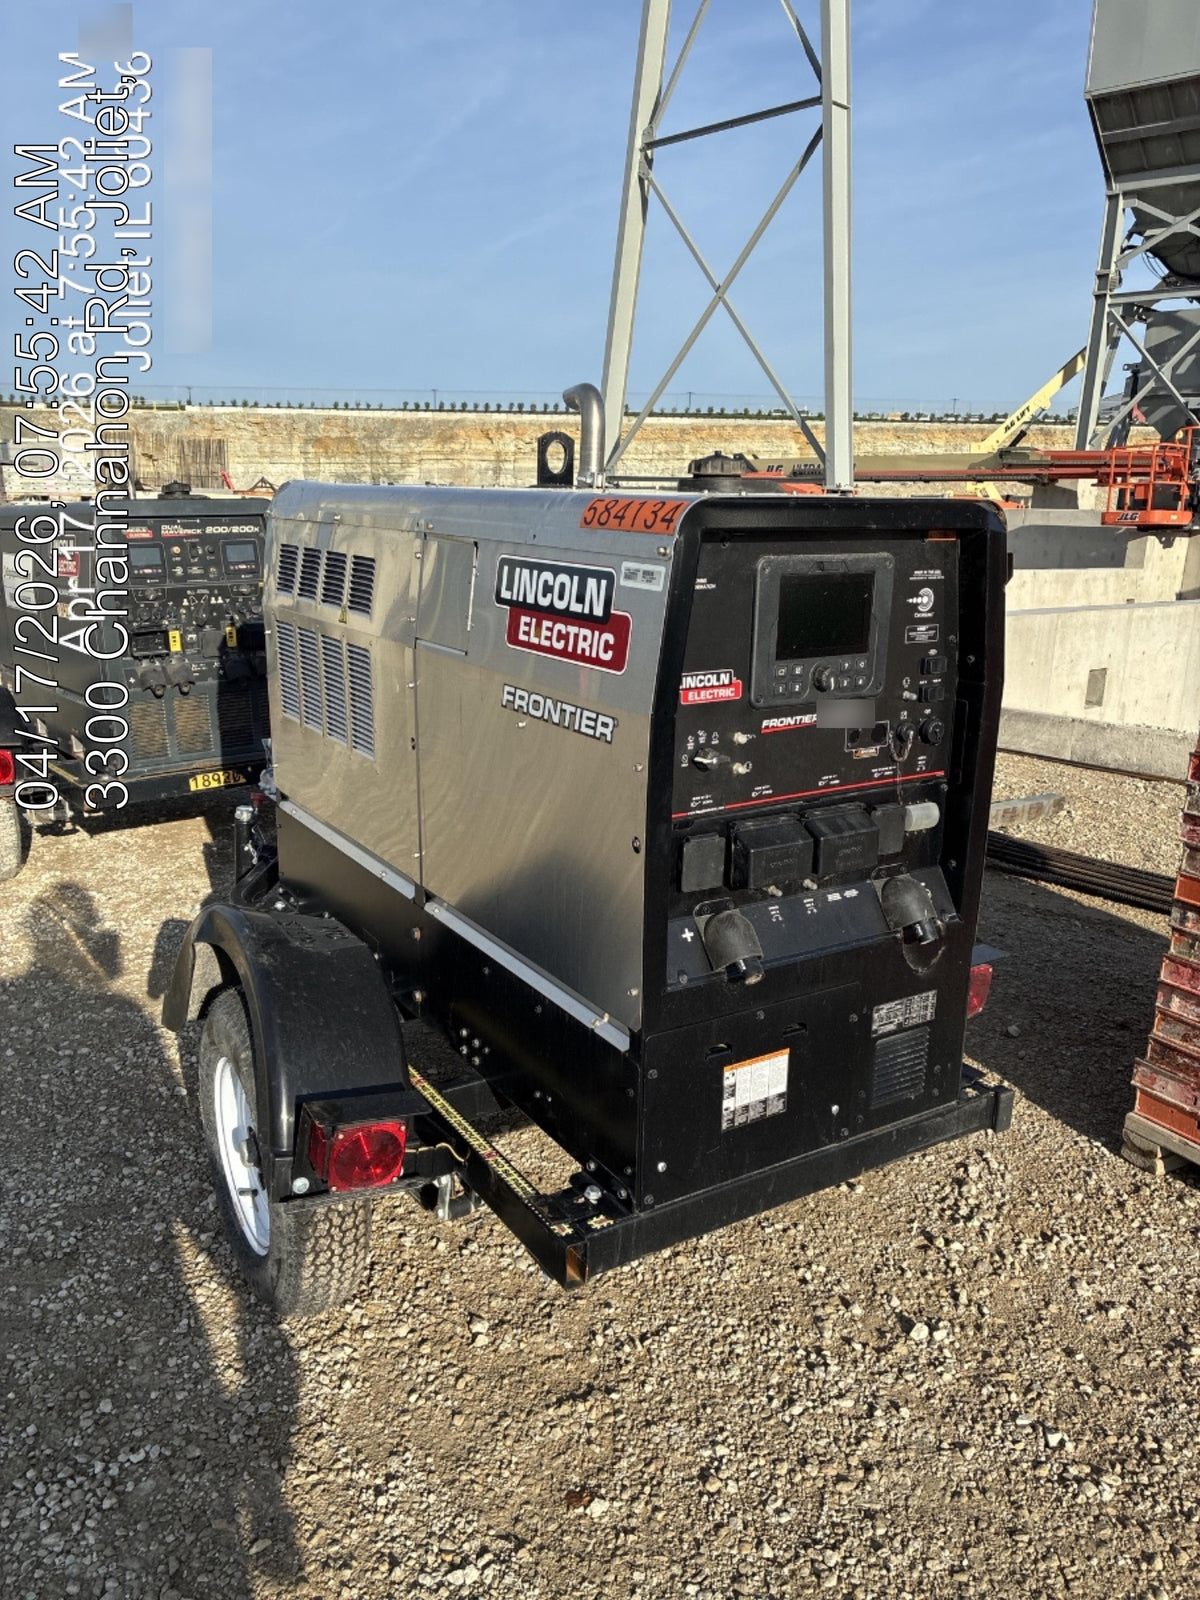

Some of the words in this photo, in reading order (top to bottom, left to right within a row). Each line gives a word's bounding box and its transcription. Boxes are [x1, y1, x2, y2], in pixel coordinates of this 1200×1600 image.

[583, 499, 683, 531] 584134
[1117, 511, 1140, 521] JLG
[499, 564, 608, 618] LINCOLN
[518, 614, 616, 662] ELECTRIC
[501, 684, 615, 744] FRONTIER
[687, 687, 736, 702] ELECTRIC
